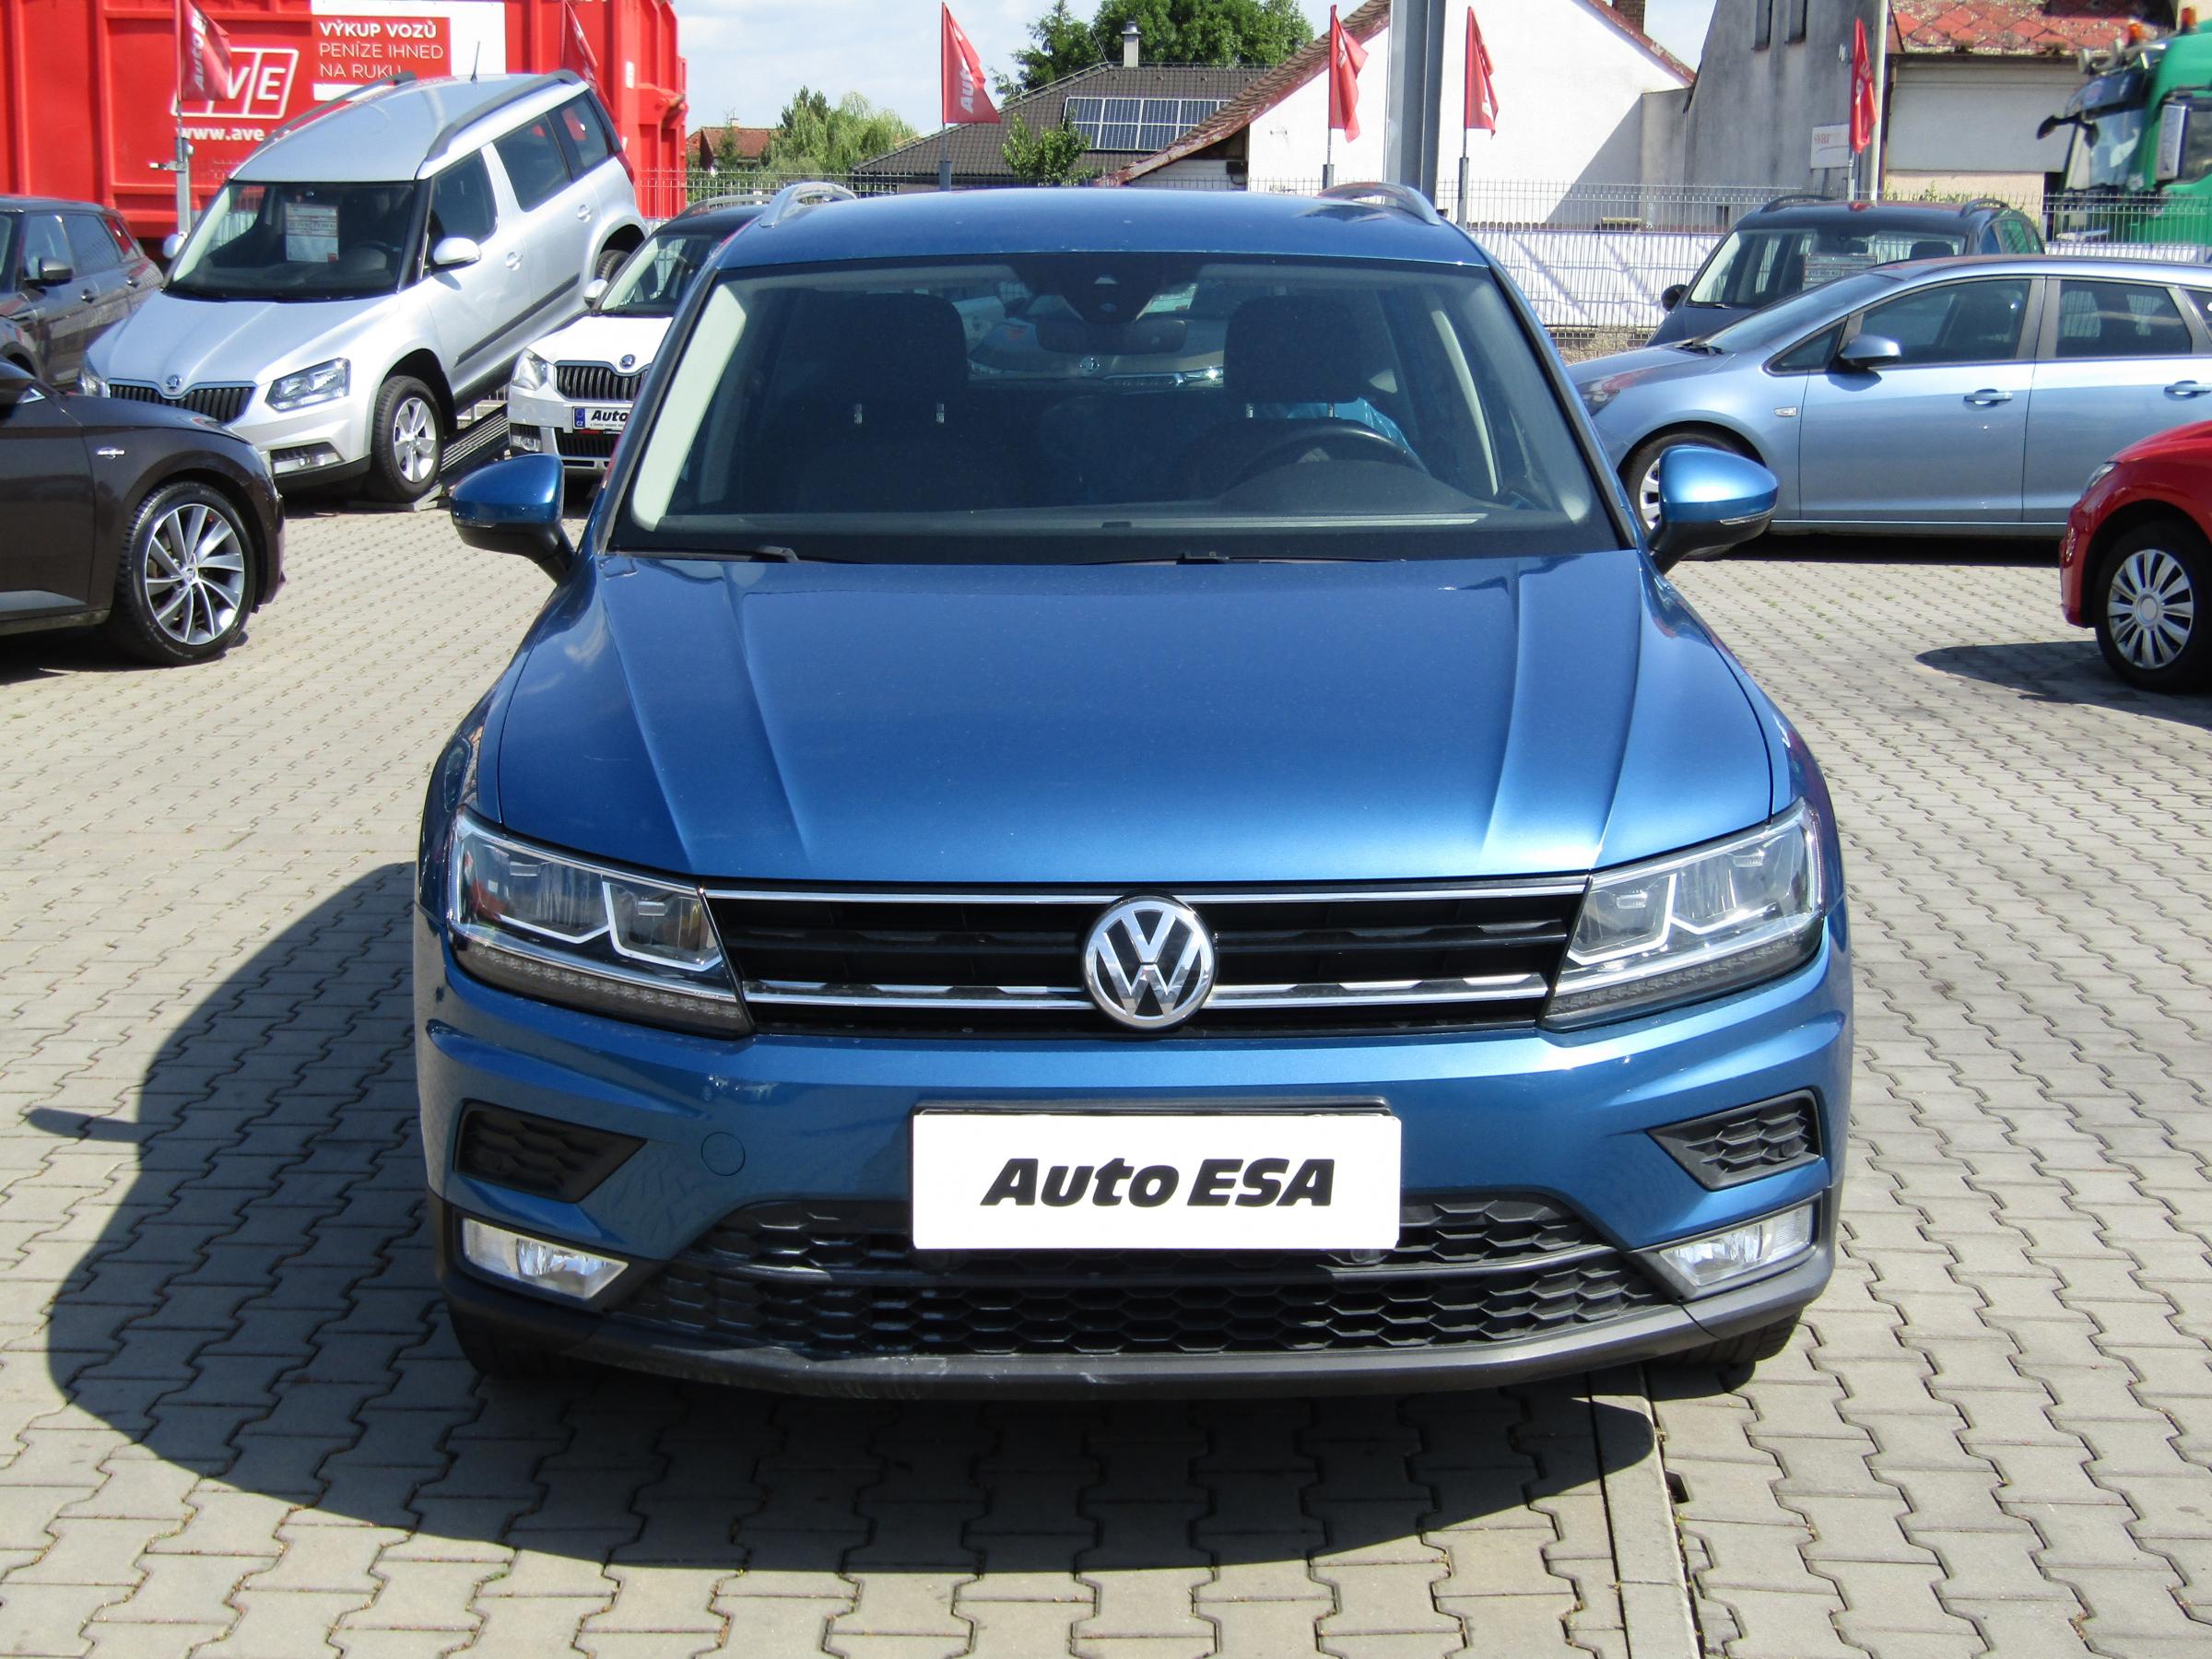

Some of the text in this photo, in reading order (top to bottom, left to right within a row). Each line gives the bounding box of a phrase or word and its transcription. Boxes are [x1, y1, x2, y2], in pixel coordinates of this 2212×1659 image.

[319, 19, 437, 39] VÝKUP VOZŮ
[319, 41, 444, 60] PENÍZE IHNED
[319, 64, 347, 78] NA
[227, 66, 287, 100] VE
[980, 1158, 1335, 1208] Auto ESA
